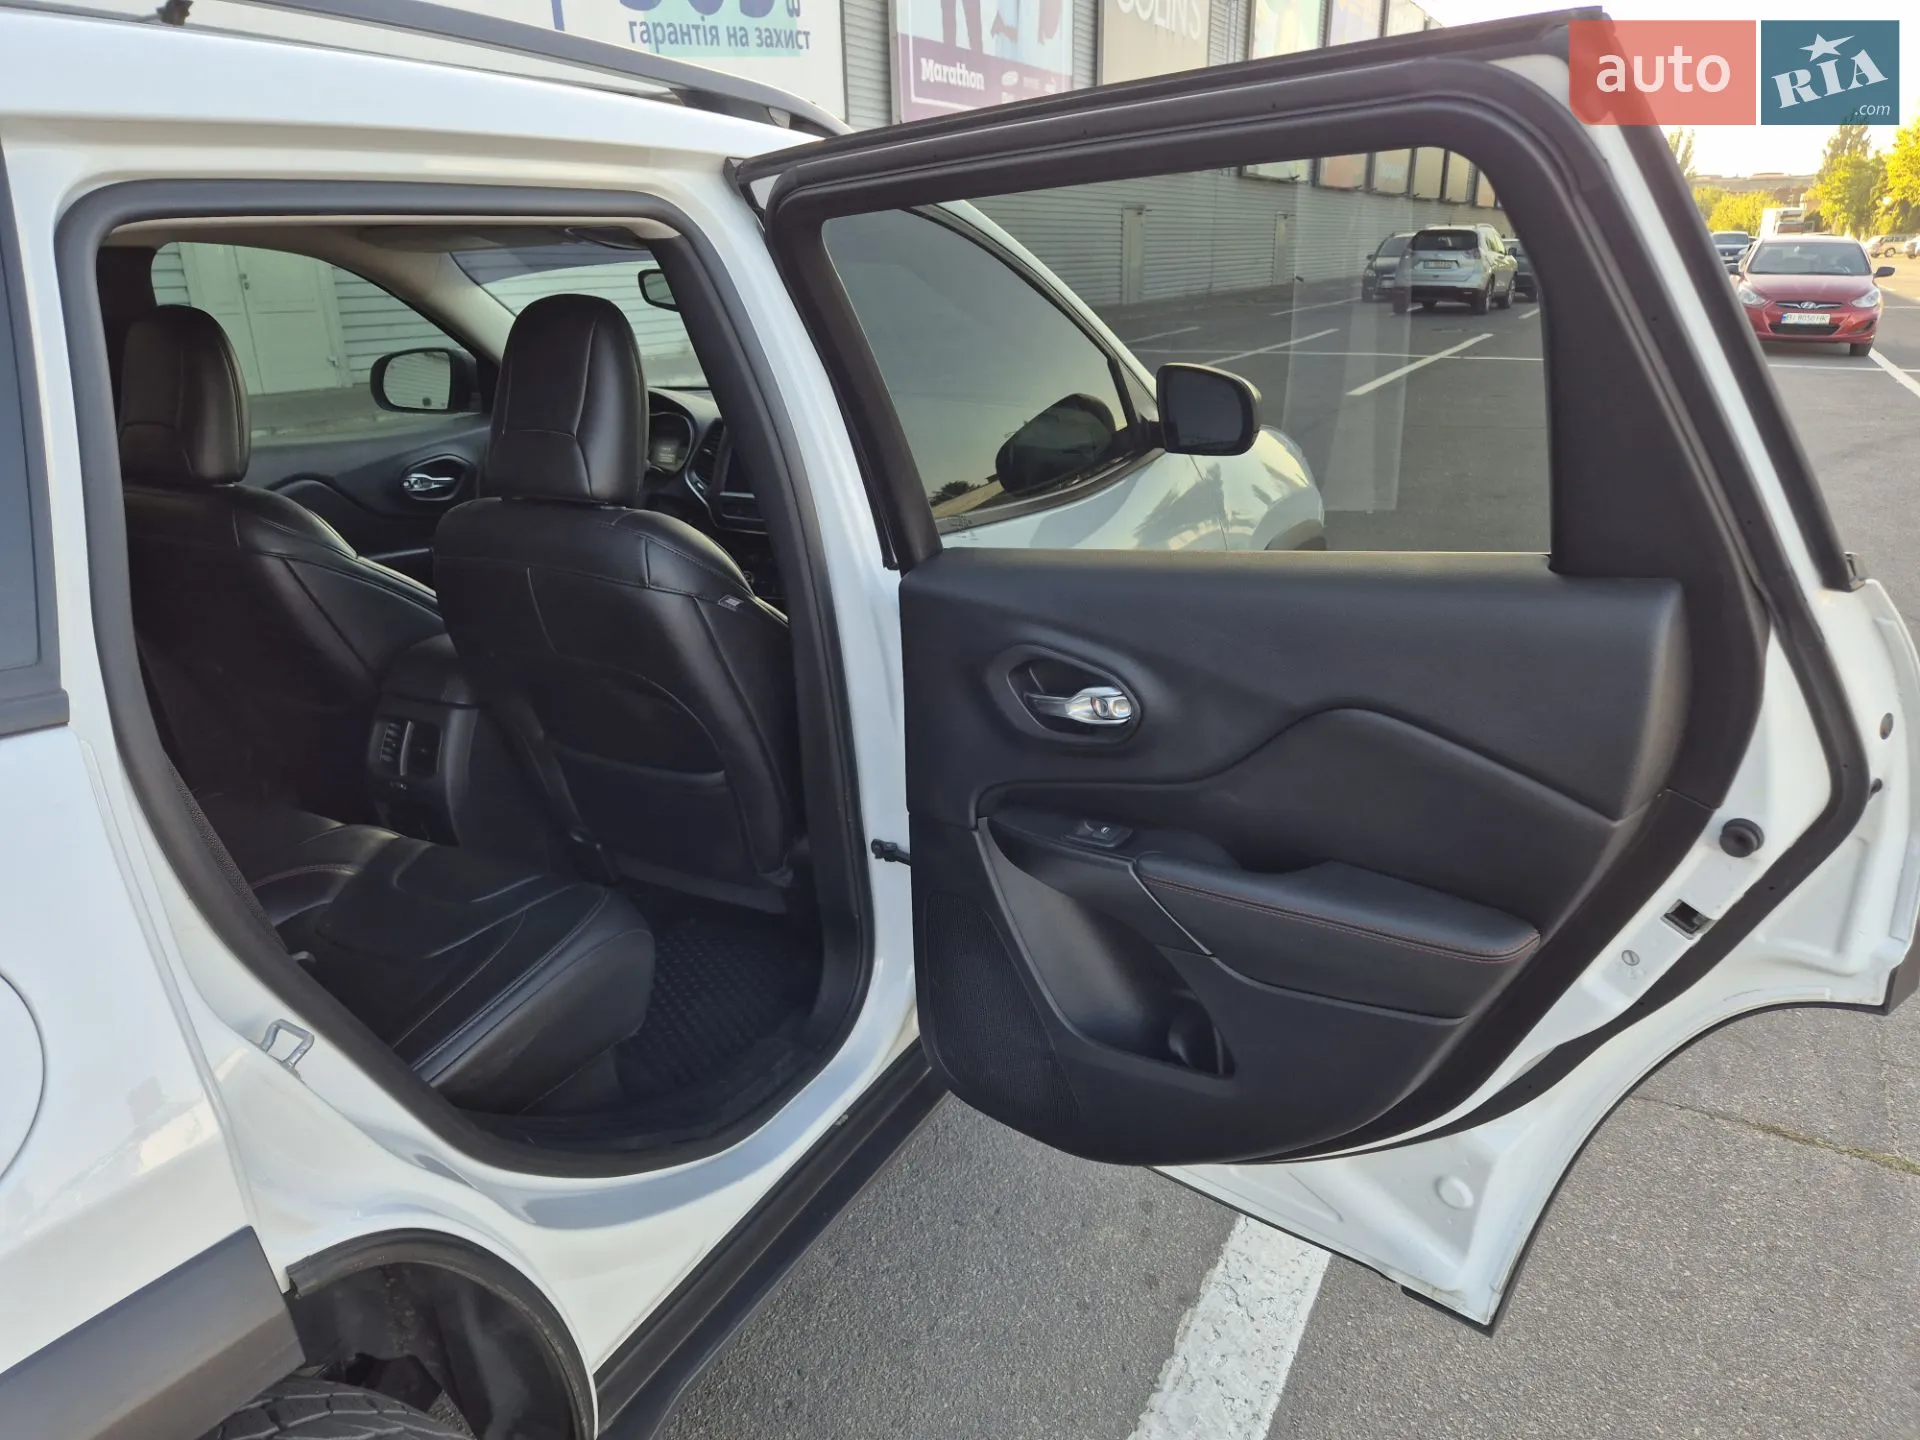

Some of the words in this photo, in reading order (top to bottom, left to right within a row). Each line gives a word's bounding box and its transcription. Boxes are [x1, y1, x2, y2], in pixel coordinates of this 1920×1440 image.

[628, 15, 720, 54] гарантія
[726, 25, 750, 47] на
[754, 26, 811, 50] захист
[920, 58, 985, 91] Marathon
